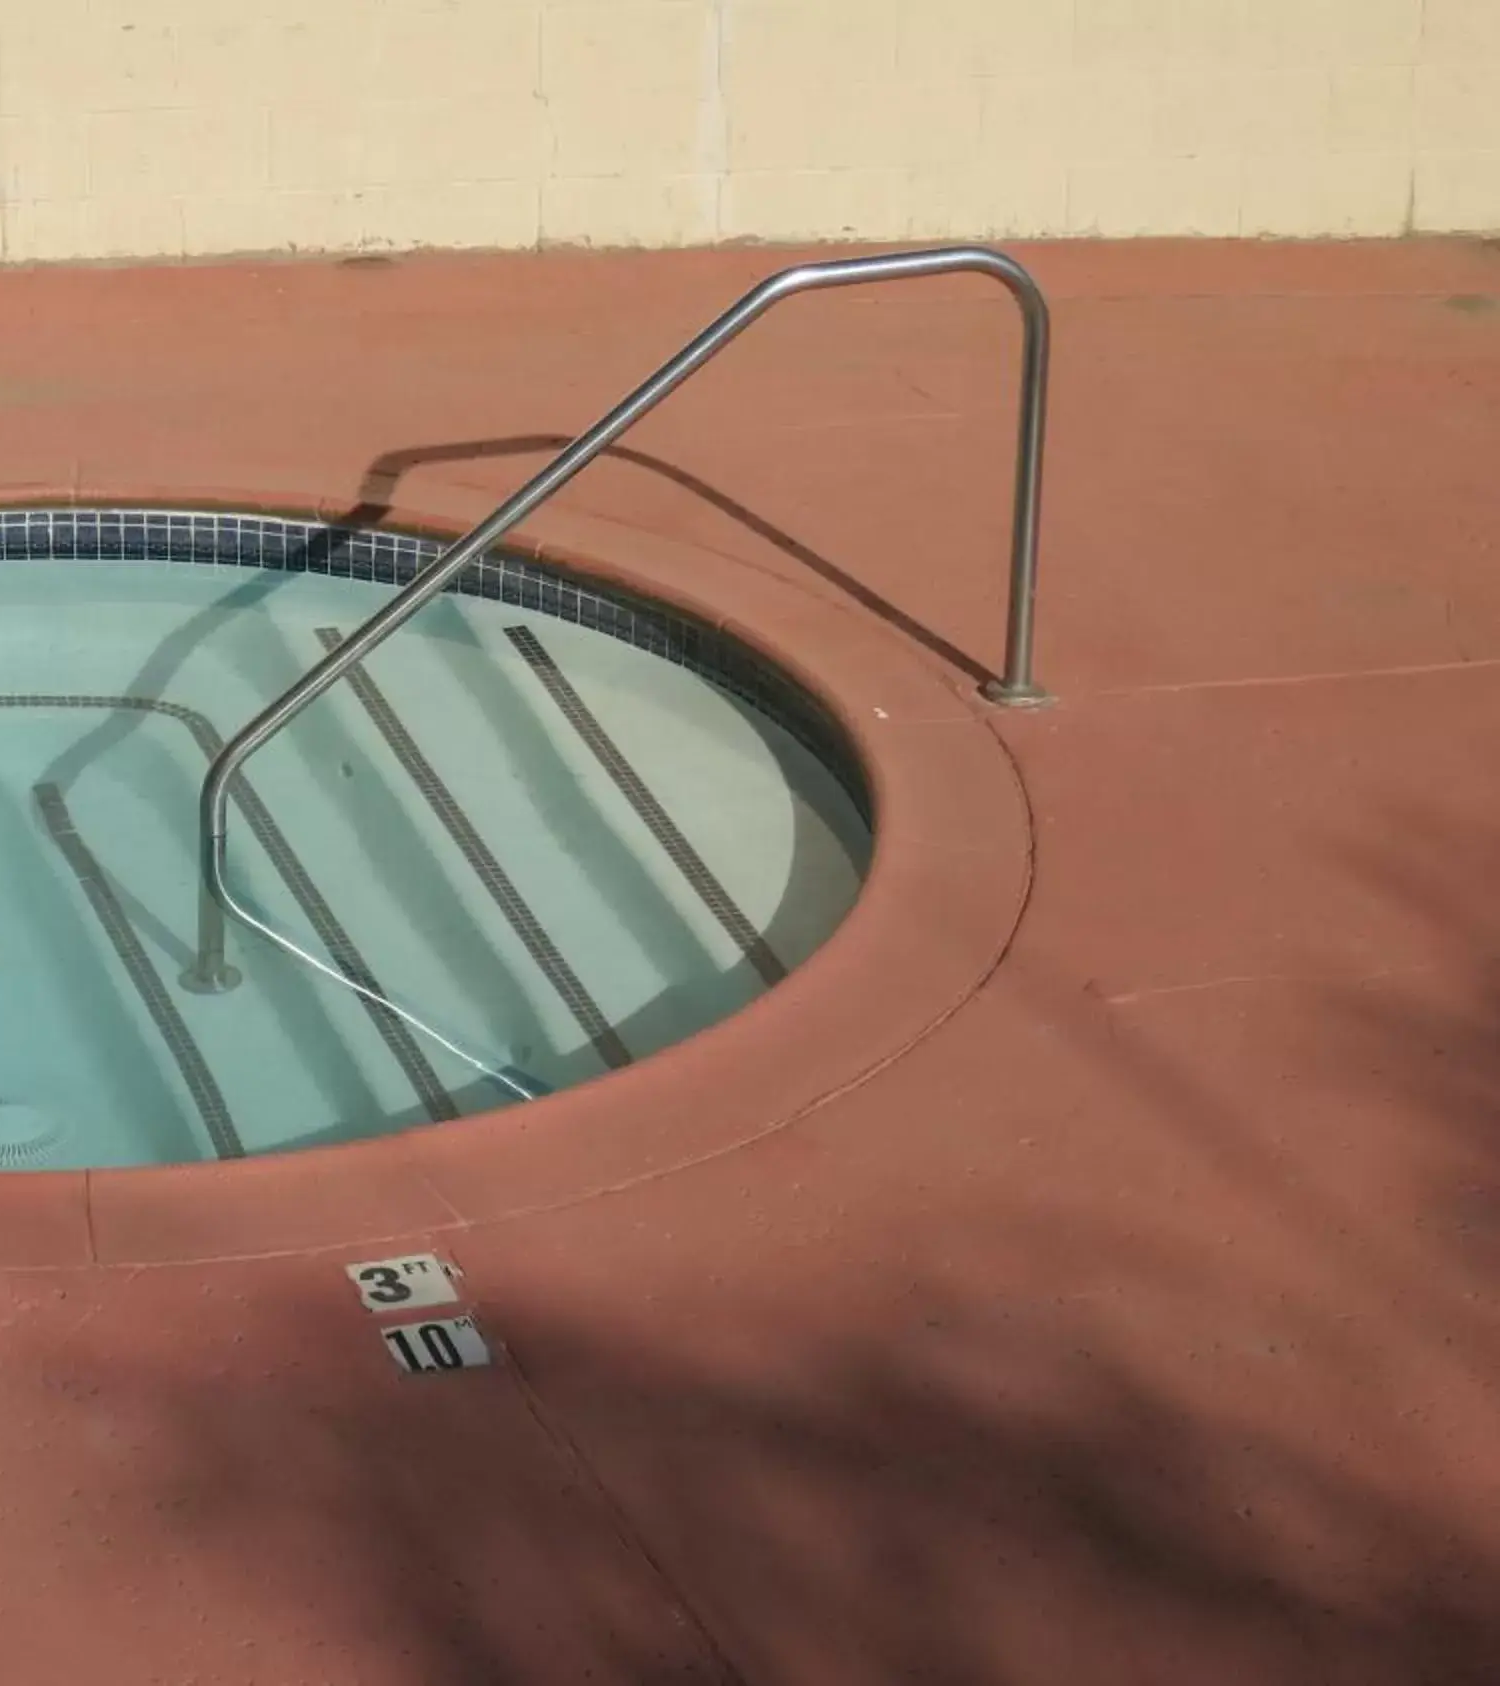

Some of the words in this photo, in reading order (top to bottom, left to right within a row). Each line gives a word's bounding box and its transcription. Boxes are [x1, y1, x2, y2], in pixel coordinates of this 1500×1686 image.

[359, 1267, 412, 1303] 3
[401, 1260, 429, 1275] FT
[385, 1324, 464, 1372] 1.0
